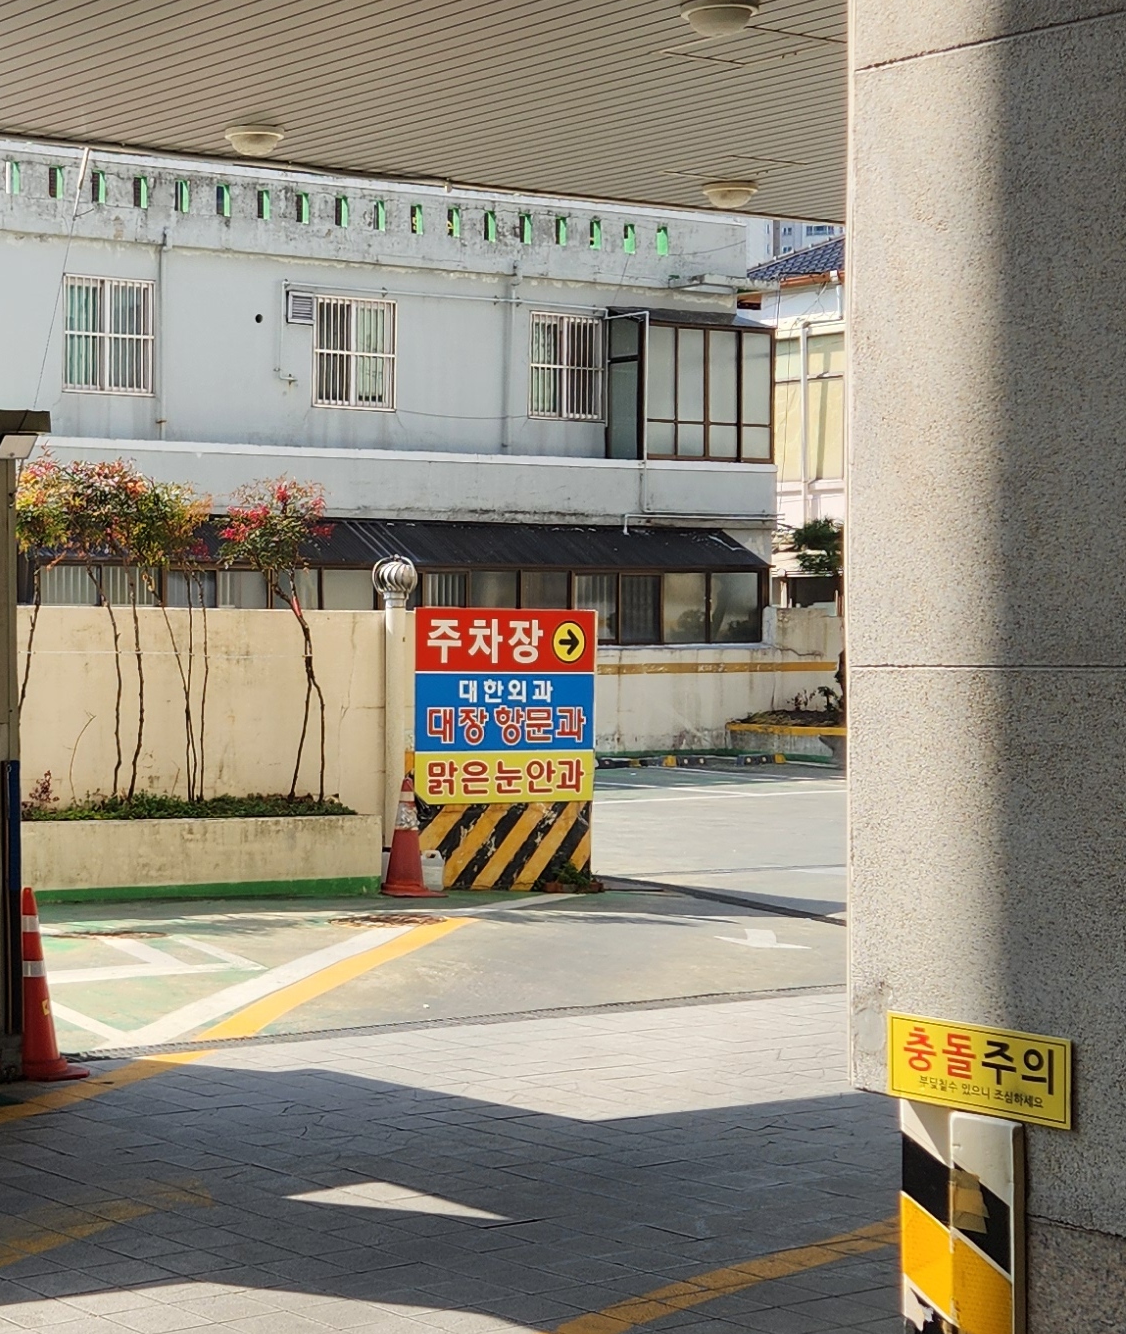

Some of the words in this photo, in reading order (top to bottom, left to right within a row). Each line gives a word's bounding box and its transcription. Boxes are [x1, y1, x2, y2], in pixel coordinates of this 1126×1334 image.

[427, 618, 543, 664] 주차장
[459, 679, 553, 703] 대한외과
[426, 759, 585, 796] 맑은눈안과
[993, 1089, 1043, 1108] 조심하세요
